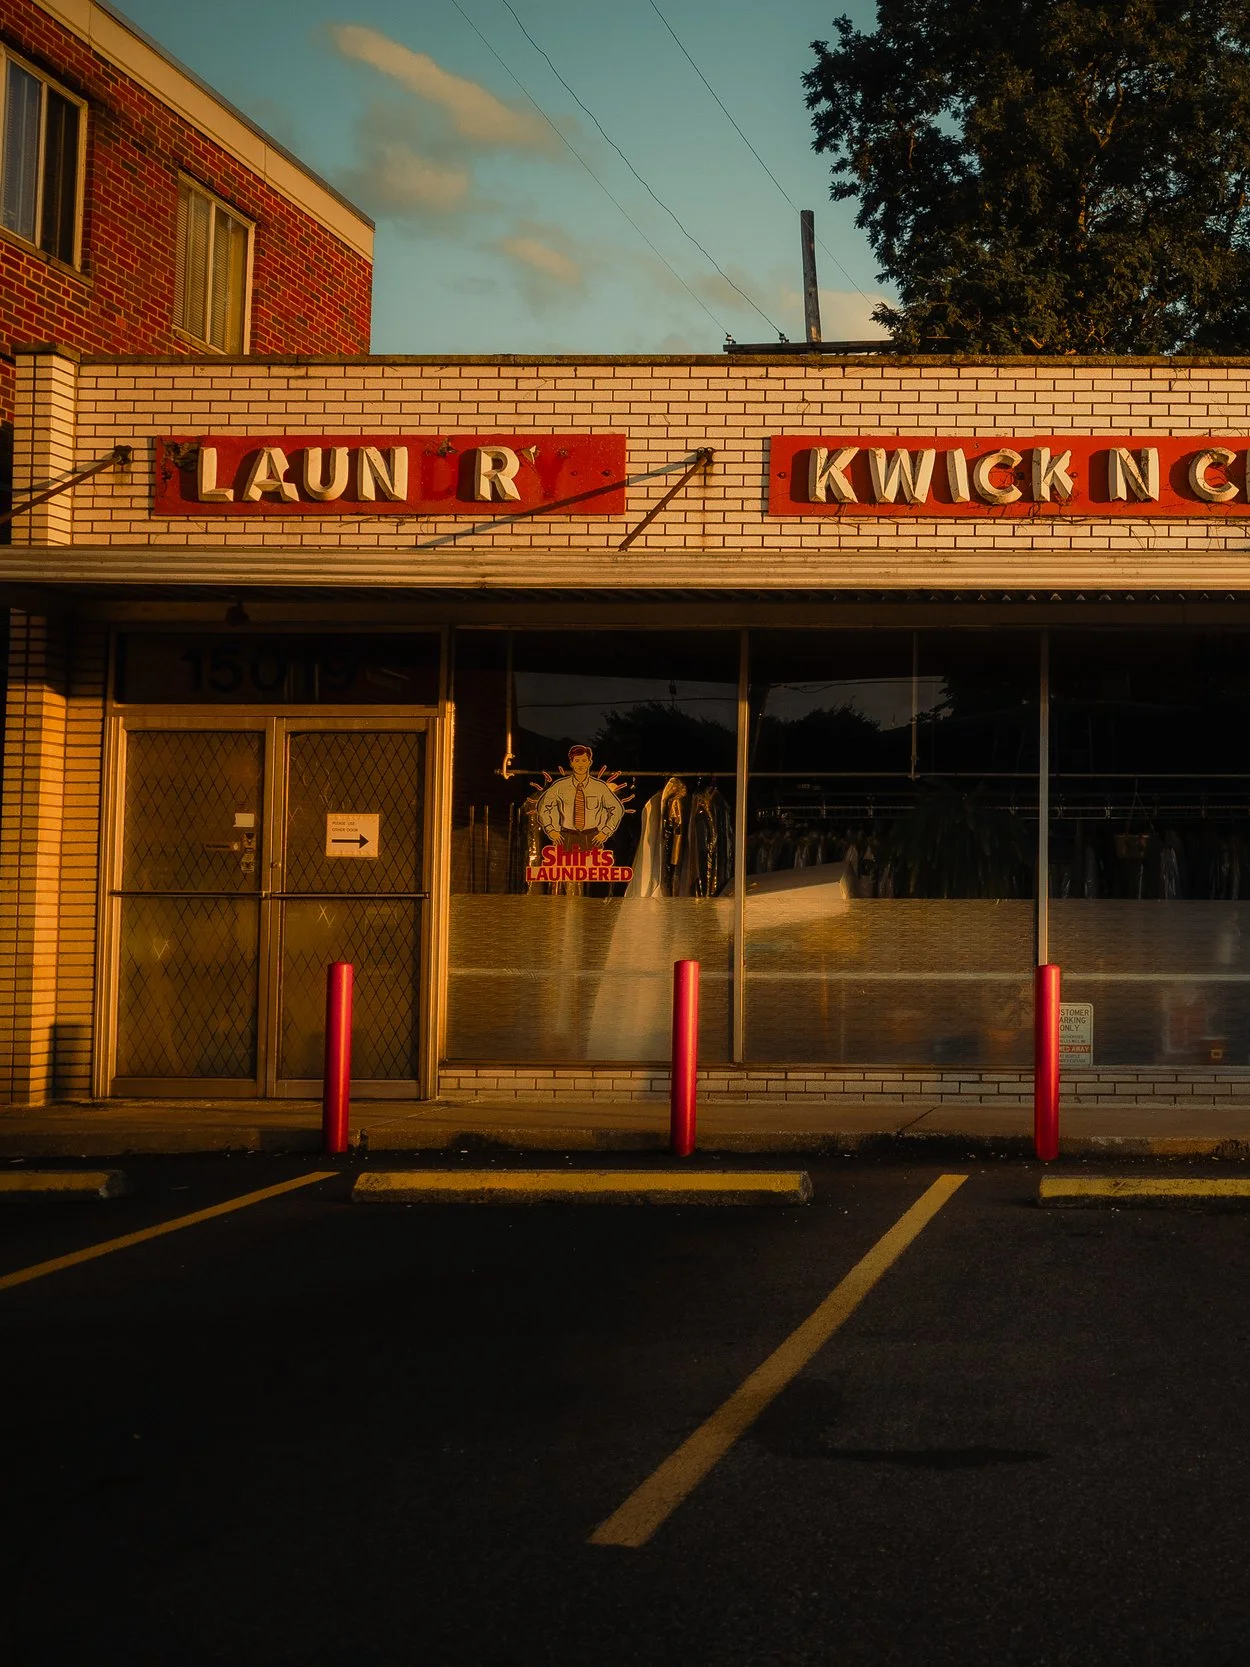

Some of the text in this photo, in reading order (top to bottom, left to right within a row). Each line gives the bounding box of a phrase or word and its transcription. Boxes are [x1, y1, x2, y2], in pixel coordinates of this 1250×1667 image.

[808, 446, 1074, 504] KWICK
[1107, 446, 1160, 502] N
[542, 844, 614, 867] Shirts
[526, 867, 634, 881] LAUNDERED
